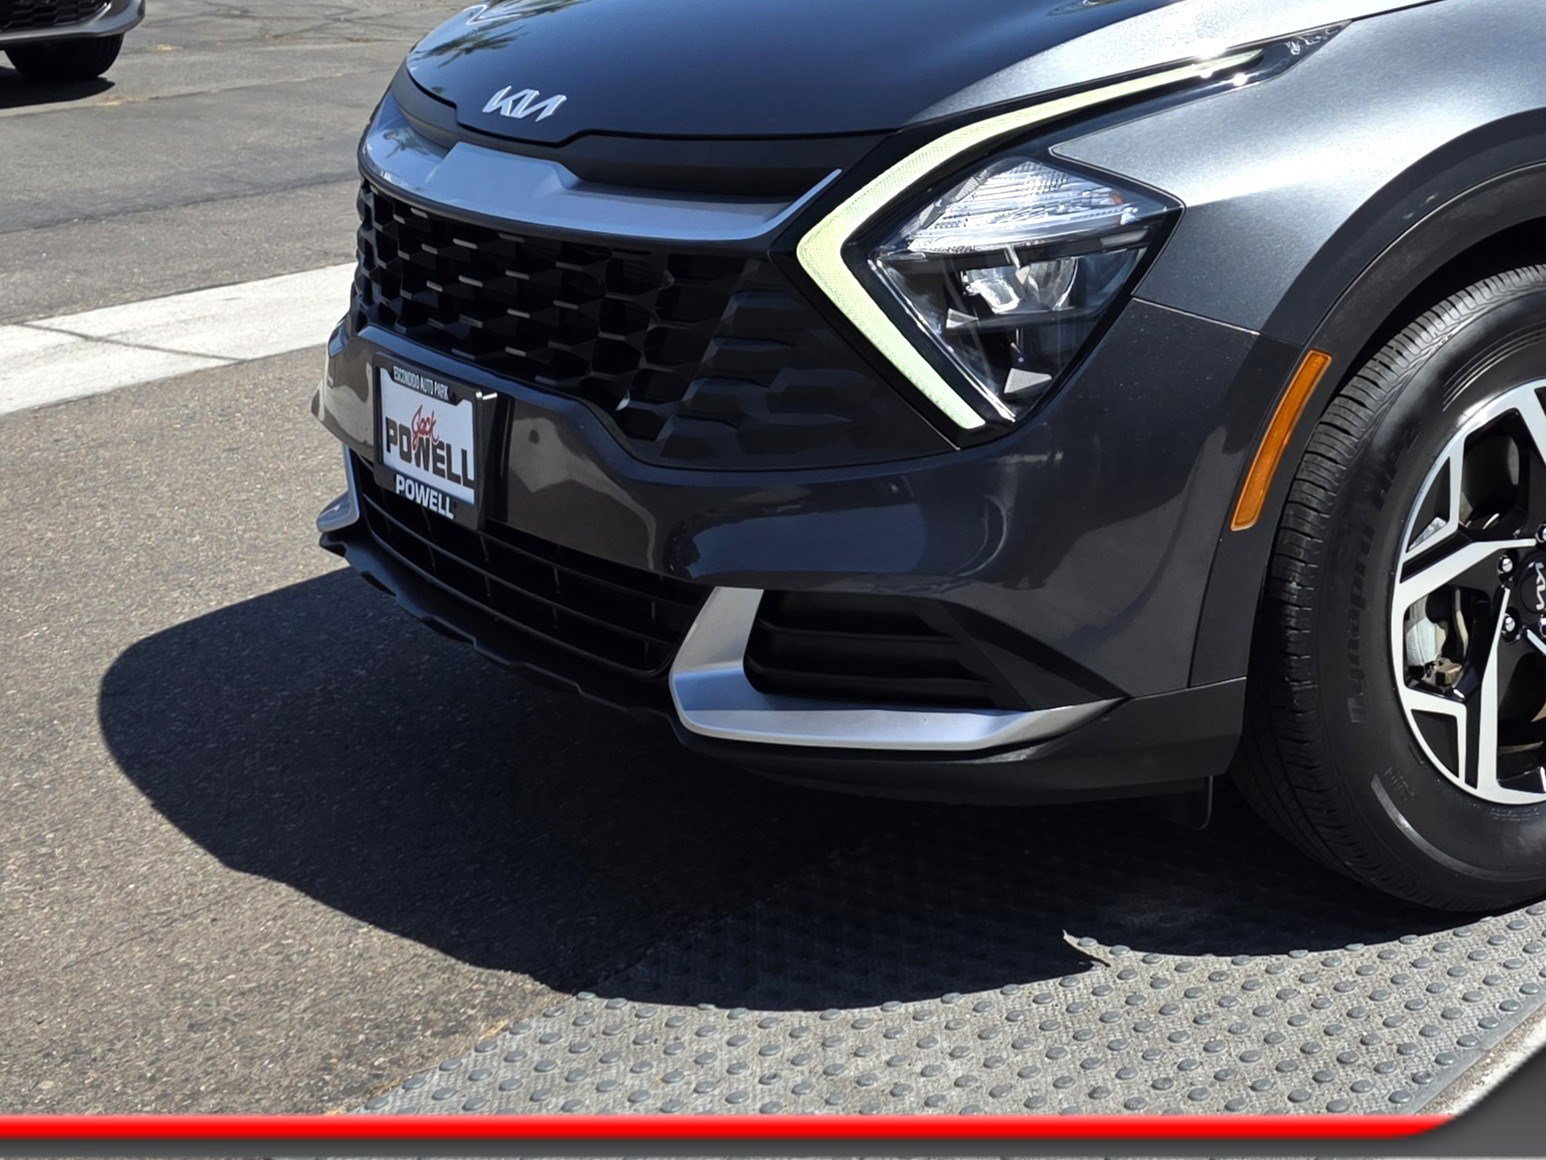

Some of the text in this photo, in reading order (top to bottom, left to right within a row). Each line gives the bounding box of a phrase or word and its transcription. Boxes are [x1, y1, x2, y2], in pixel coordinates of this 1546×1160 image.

[385, 416, 476, 488] POWELL
[411, 404, 440, 452] Jack
[395, 473, 455, 520] POWELL
